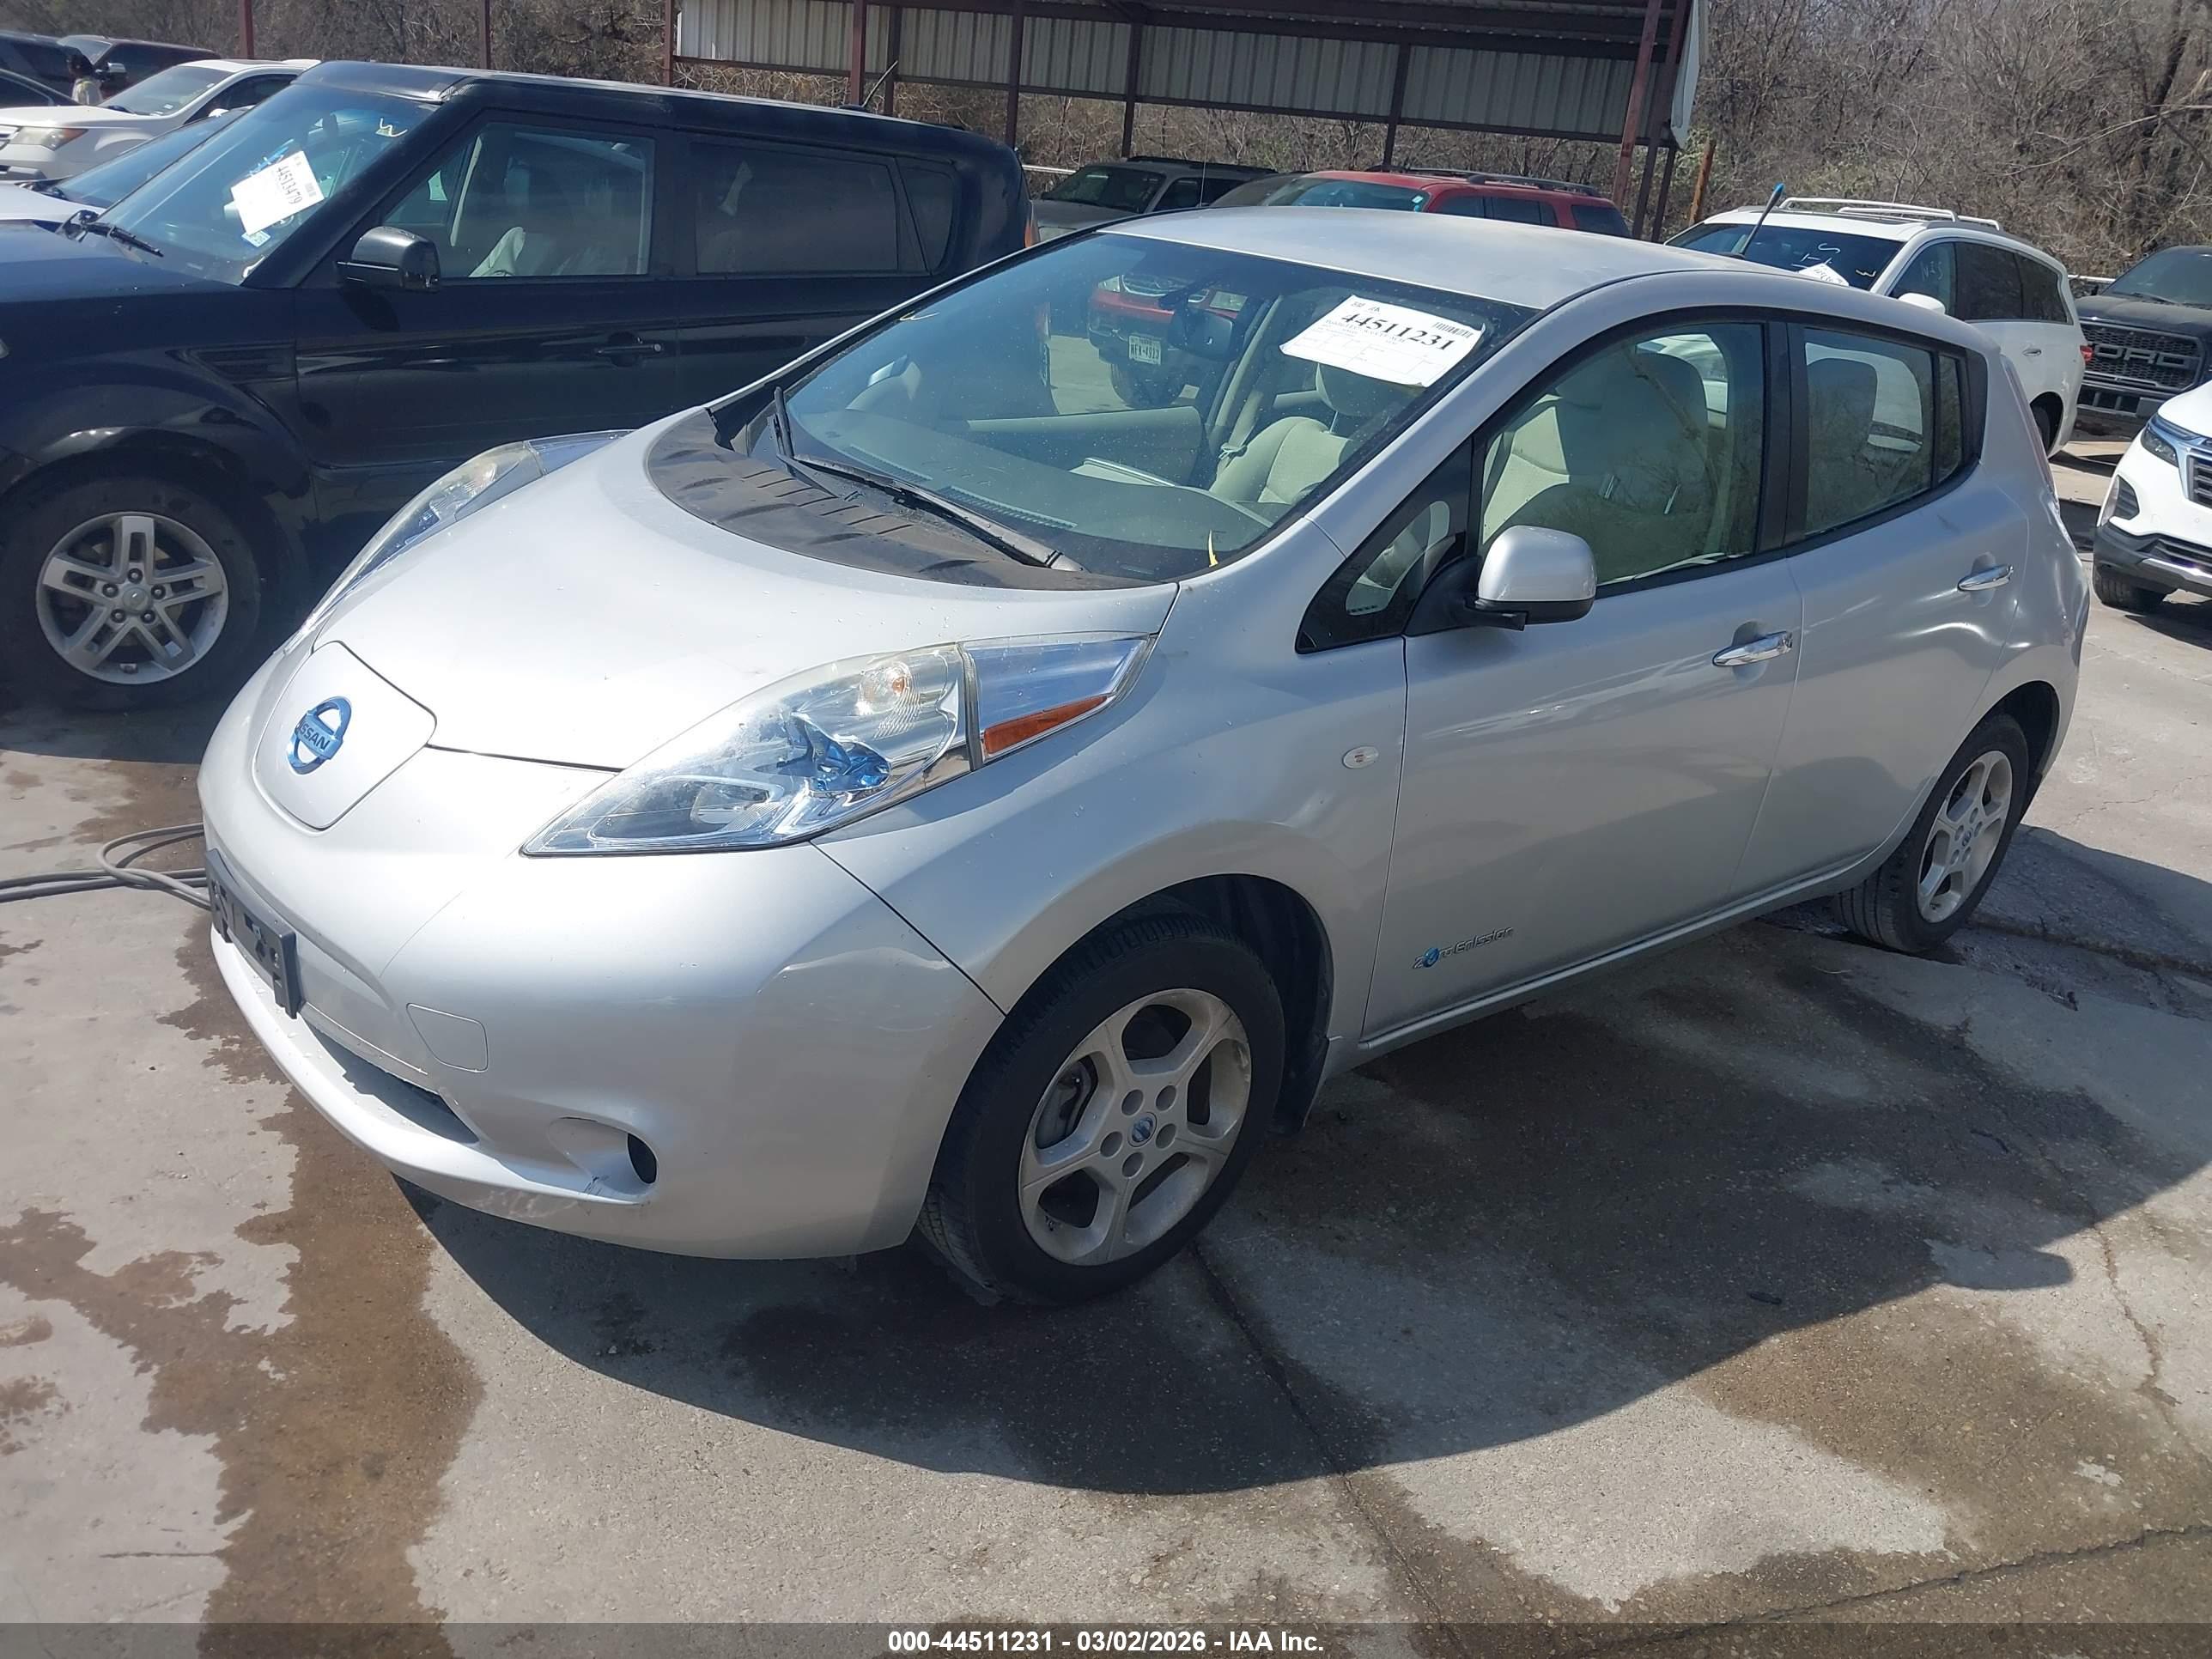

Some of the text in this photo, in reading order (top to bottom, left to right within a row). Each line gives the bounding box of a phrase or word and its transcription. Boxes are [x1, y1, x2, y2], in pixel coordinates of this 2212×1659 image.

[276, 165, 303, 204] 44513479
[1340, 313, 1456, 350] 44511231
[2089, 342, 2188, 368] ORD
